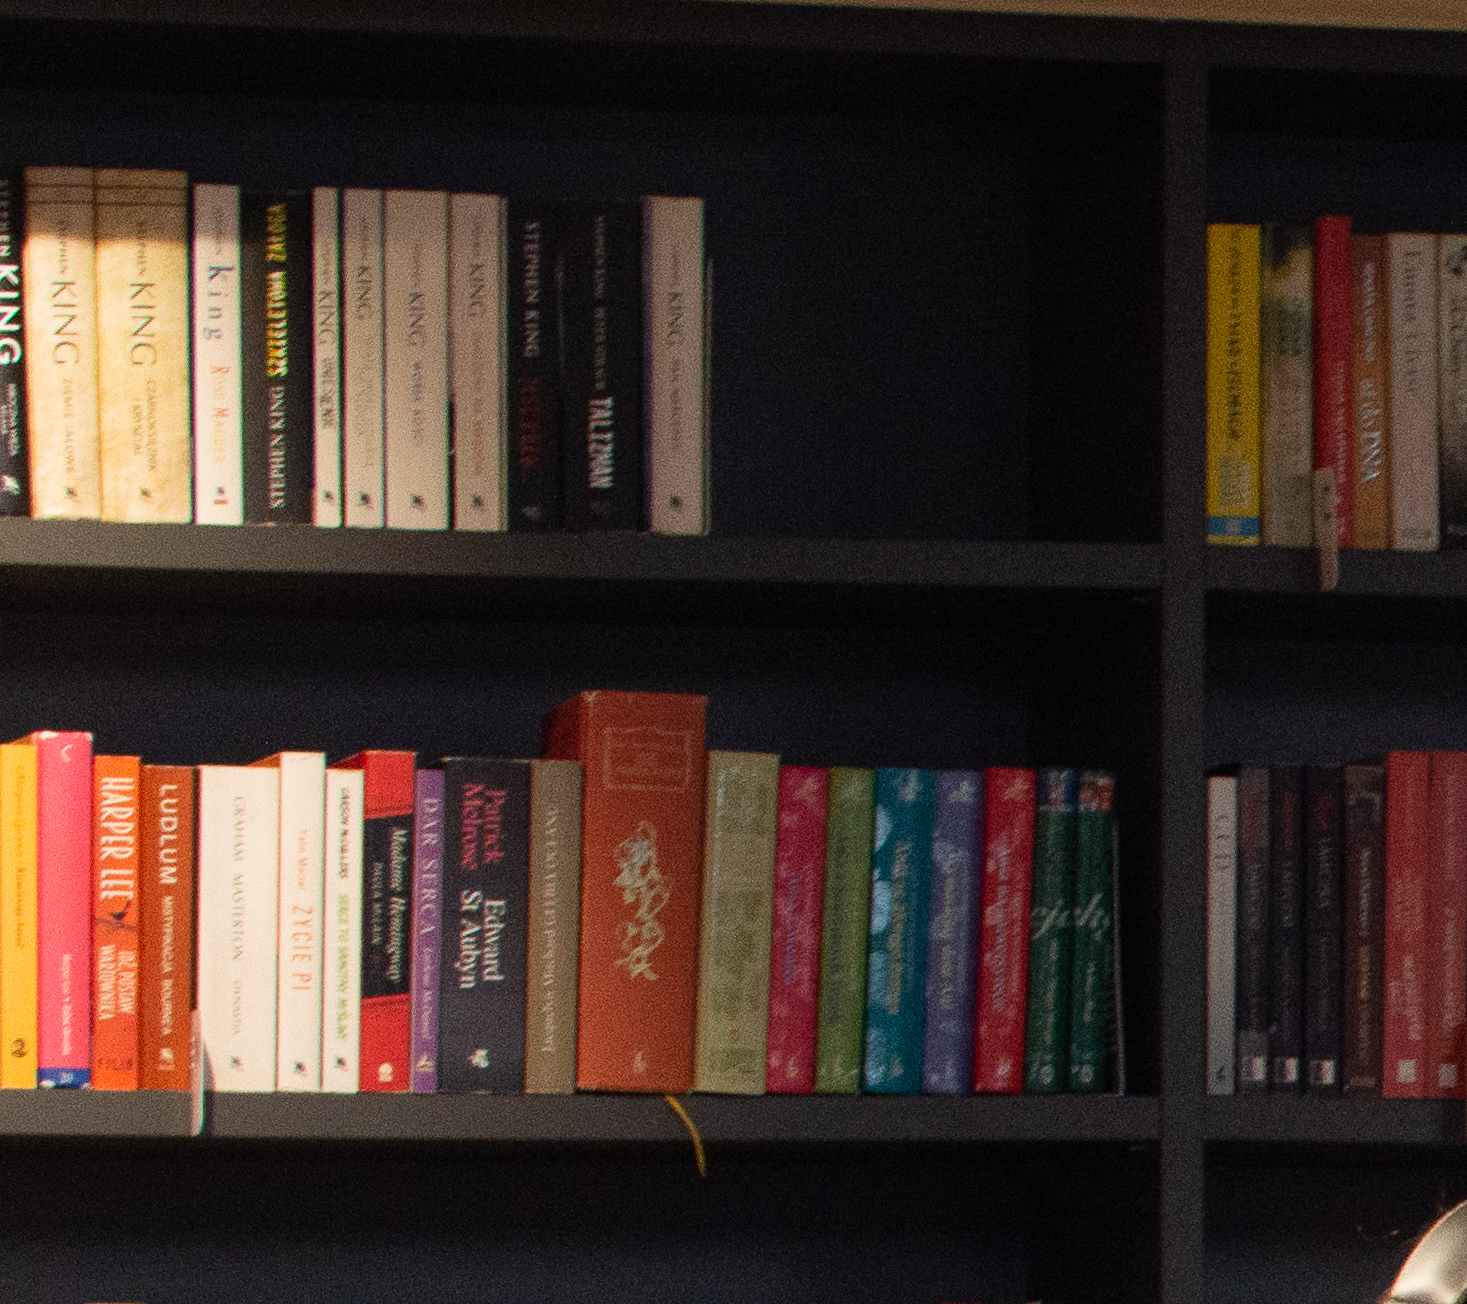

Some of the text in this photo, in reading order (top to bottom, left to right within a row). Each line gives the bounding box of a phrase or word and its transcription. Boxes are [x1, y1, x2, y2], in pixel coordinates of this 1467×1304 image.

[52, 281, 79, 365] KING
[131, 282, 157, 367] KING
[319, 290, 335, 346] KING
[357, 266, 372, 320] KING
[409, 292, 426, 346] KING
[470, 263, 485, 317] KING
[524, 222, 539, 357] STEPHEN KING
[667, 292, 684, 346] KING
[101, 777, 134, 899] HARPER LEE
[420, 799, 438, 934] DAR SERCA
[460, 783, 484, 871] Melrose
[484, 789, 506, 864] Patrick
[454, 890, 482, 989] St Aubyn
[482, 900, 505, 981] Edward
